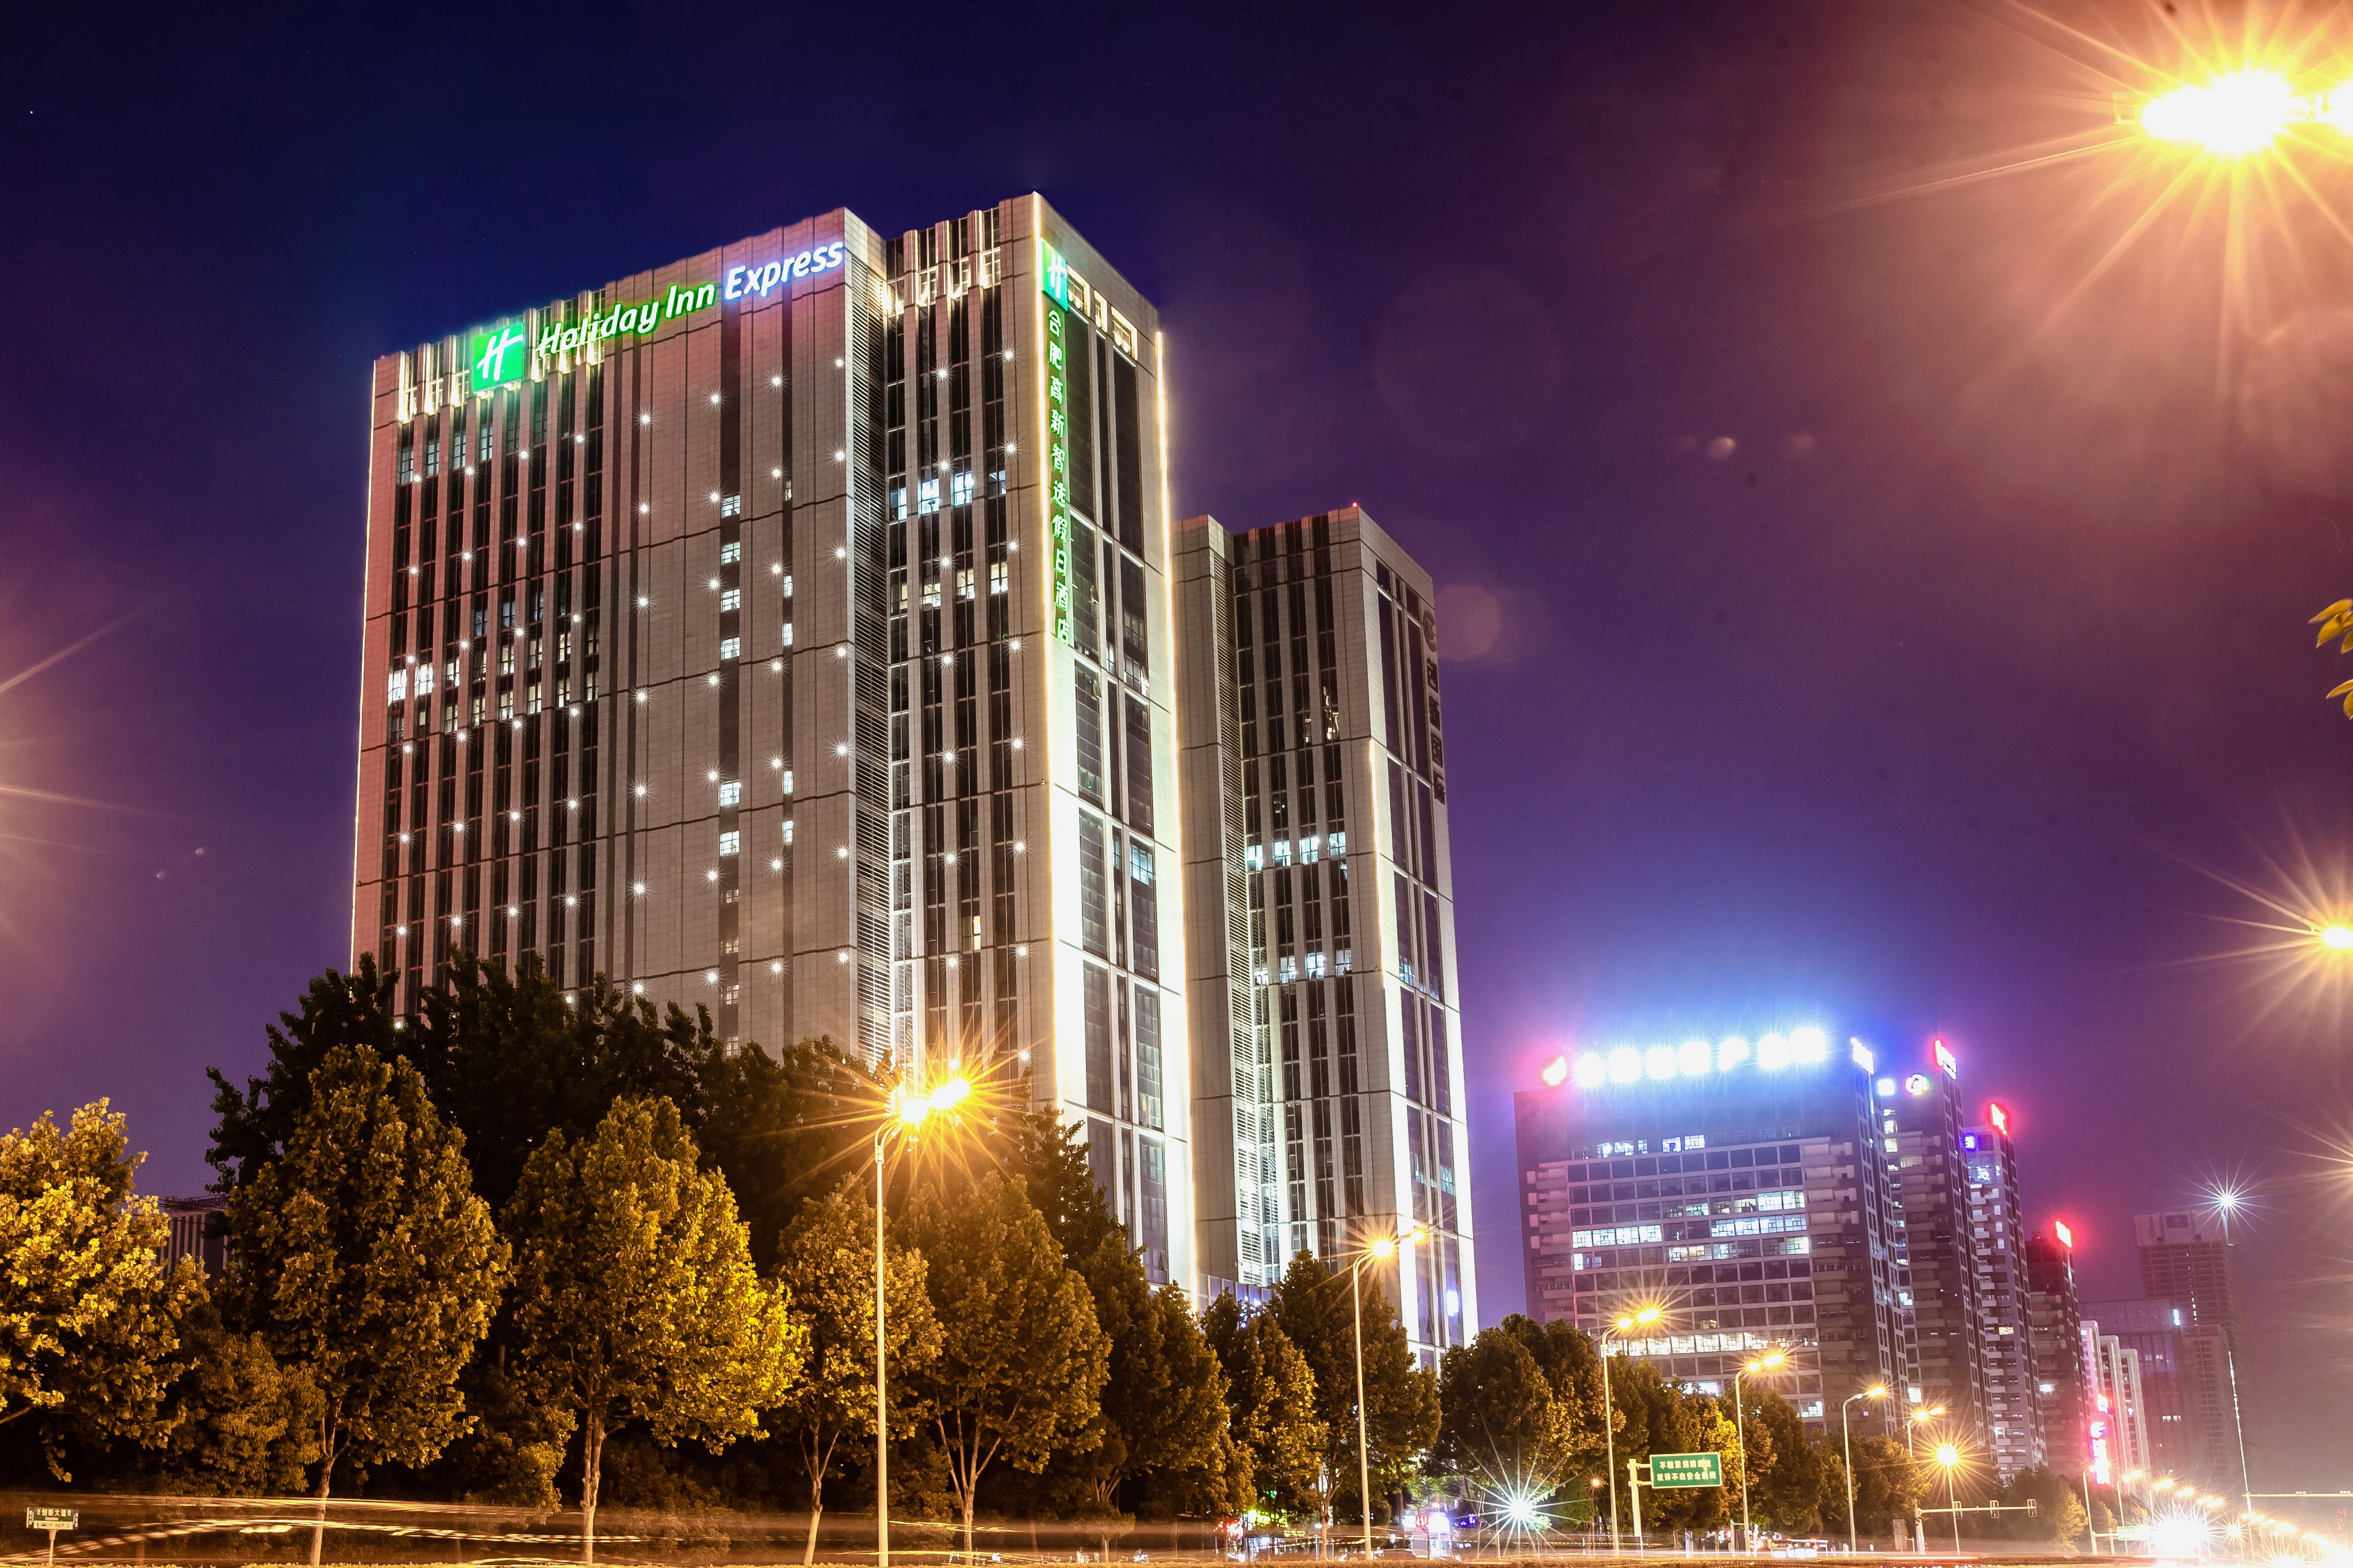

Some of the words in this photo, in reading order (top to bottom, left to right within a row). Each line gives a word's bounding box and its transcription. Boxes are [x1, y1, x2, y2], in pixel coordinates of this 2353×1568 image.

[538, 302, 660, 358] Holiday
[665, 282, 717, 320] Inn
[724, 240, 844, 301] Express
[1048, 309, 1070, 646] 合肥高新智选假日酒店
